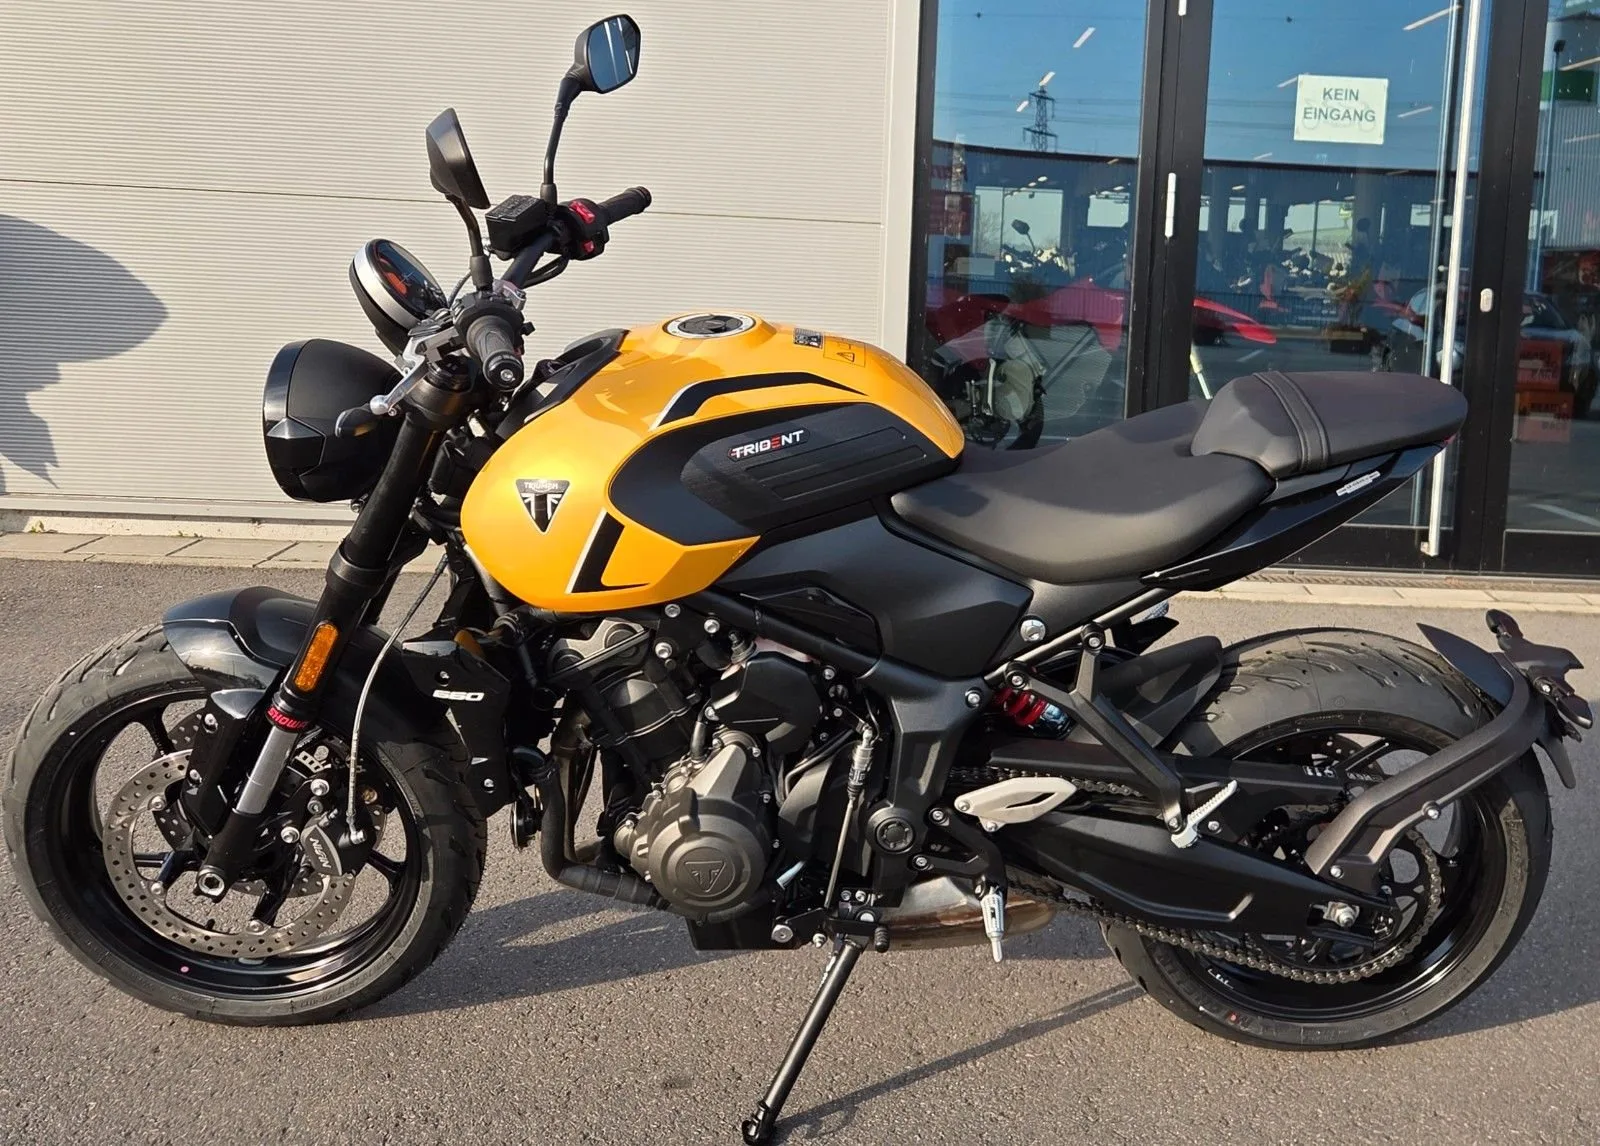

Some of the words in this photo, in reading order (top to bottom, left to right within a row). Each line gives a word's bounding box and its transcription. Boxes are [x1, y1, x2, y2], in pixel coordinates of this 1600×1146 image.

[1322, 87, 1360, 101] KEIN
[1303, 107, 1377, 122] EINGANG
[730, 429, 804, 458] TRIDENT
[432, 689, 485, 702] 660
